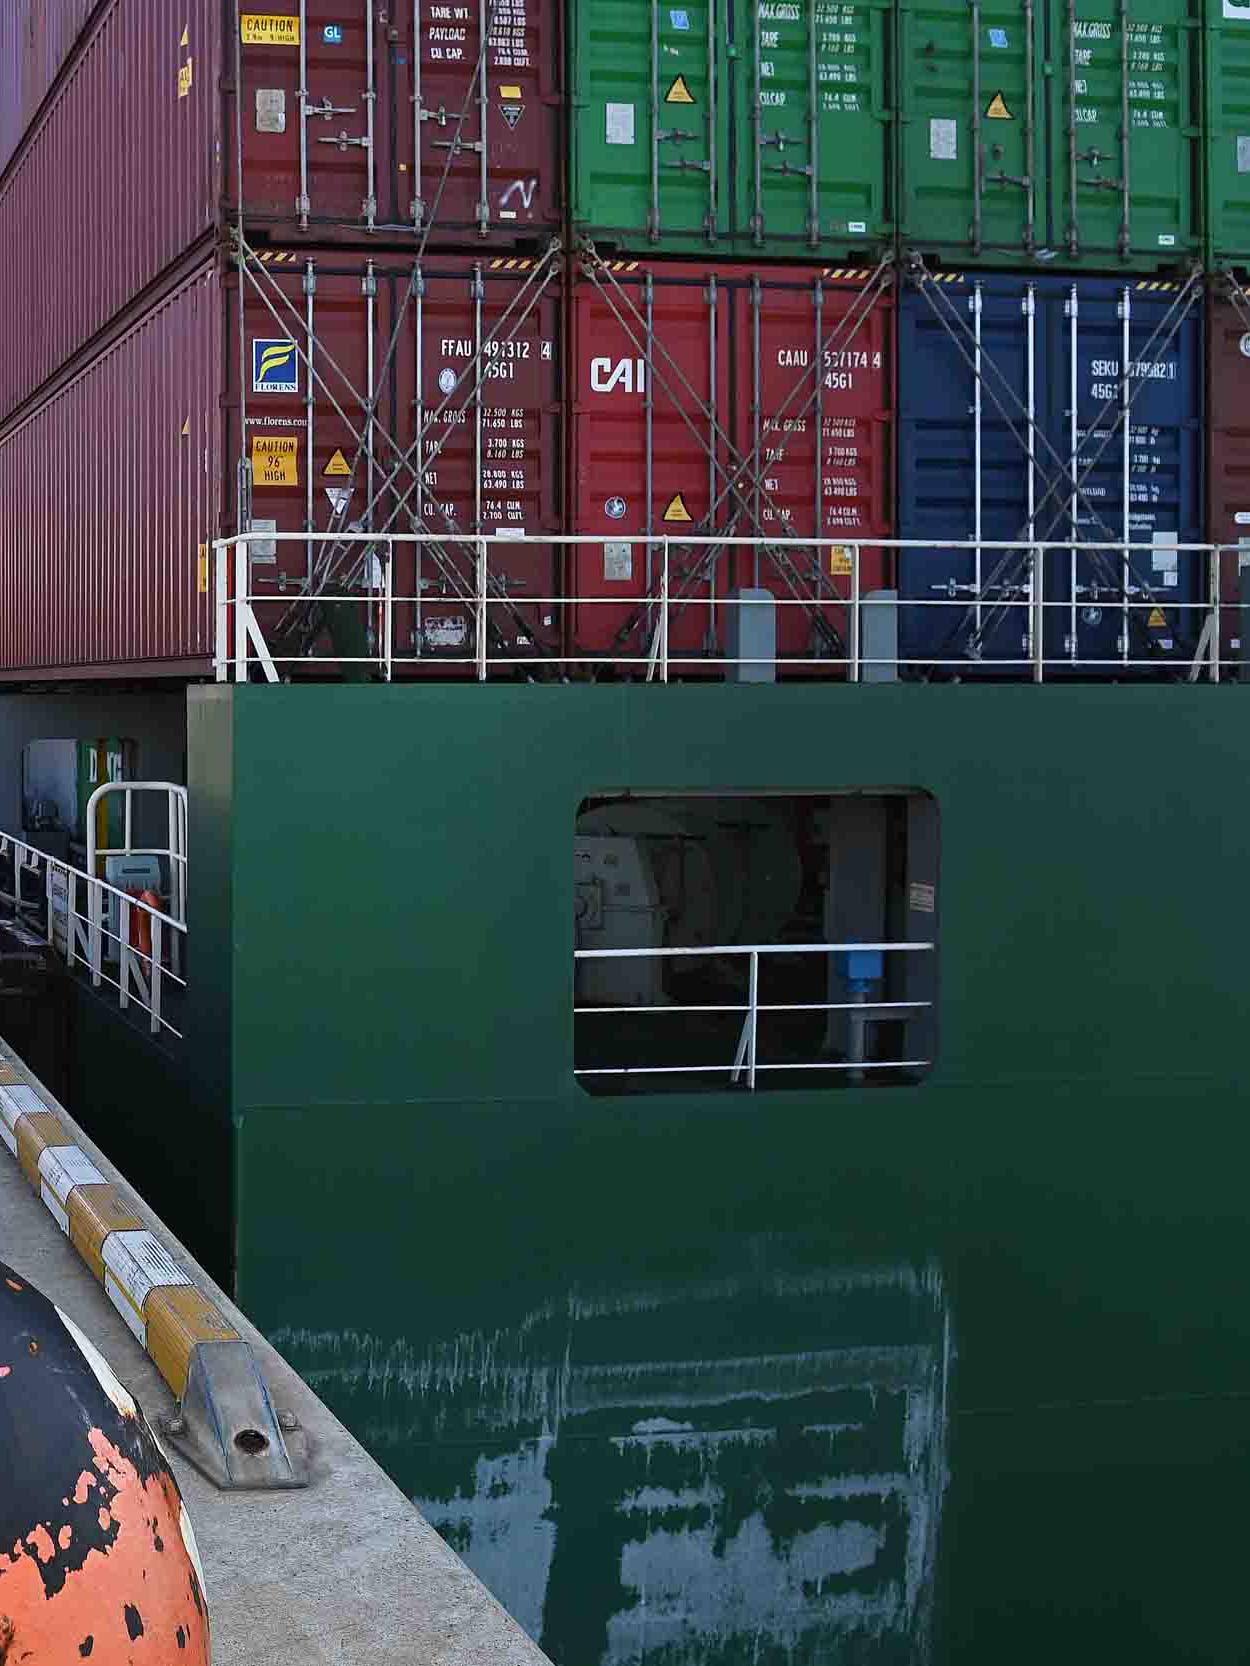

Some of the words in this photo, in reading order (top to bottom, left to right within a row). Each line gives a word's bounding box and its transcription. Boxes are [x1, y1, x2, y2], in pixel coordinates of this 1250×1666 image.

[430, 7, 451, 18] TARE
[246, 19, 293, 32] CAUTION
[324, 26, 341, 38] GL
[441, 340, 472, 357] FFAU
[541, 341, 552, 360] 4
[777, 350, 808, 367] CAAU
[872, 352, 882, 369] 4
[591, 357, 645, 393] CAI
[1091, 360, 1119, 377] SEKU
[824, 373, 853, 390] 45G1
[511, 408, 524, 417] KGS
[511, 419, 523, 428] LBS
[255, 441, 294, 453] CAUTION
[425, 440, 442, 454] TAR
[512, 439, 525, 448] KGS
[264, 470, 286, 481] HIGH
[425, 472, 438, 485] NET
[512, 480, 525, 489] LBS
